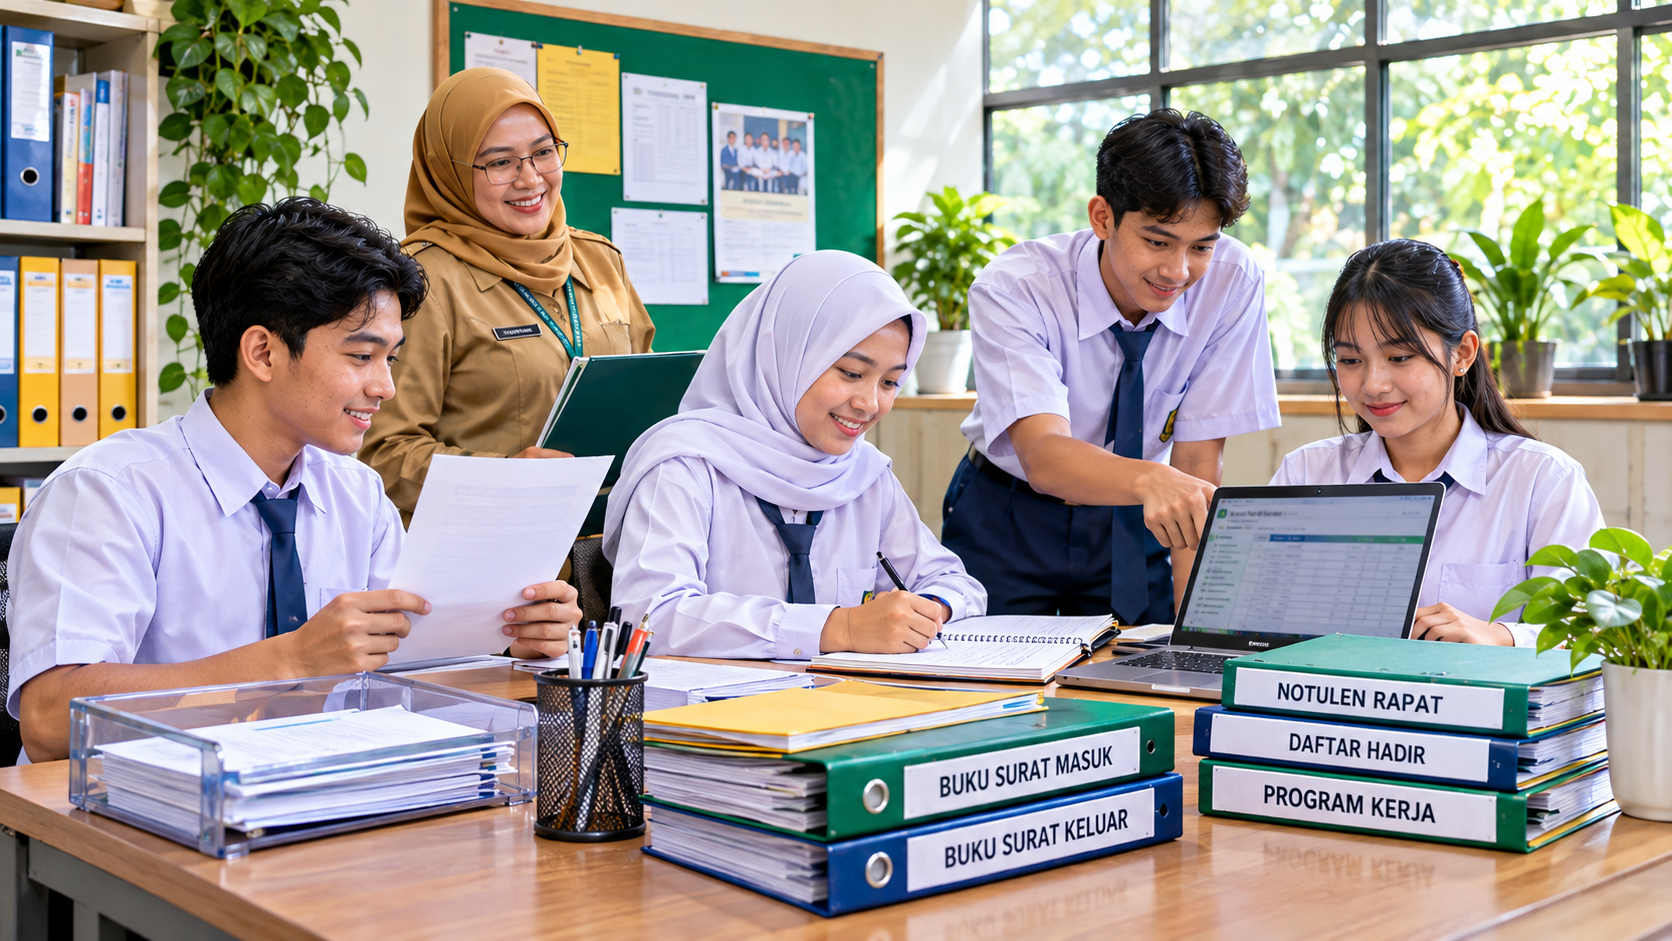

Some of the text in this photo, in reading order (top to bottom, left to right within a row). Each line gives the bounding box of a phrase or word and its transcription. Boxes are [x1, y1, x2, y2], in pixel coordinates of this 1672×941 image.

[1277, 682, 1443, 714] NOTULEN RAPAT
[1289, 733, 1426, 765] DAFTAR HADIR
[939, 745, 1113, 798] BUKU SURAT MASUK
[1263, 784, 1436, 823] PROGRAM KERJA
[944, 808, 1129, 869] BUKU SURAT KELUAR
